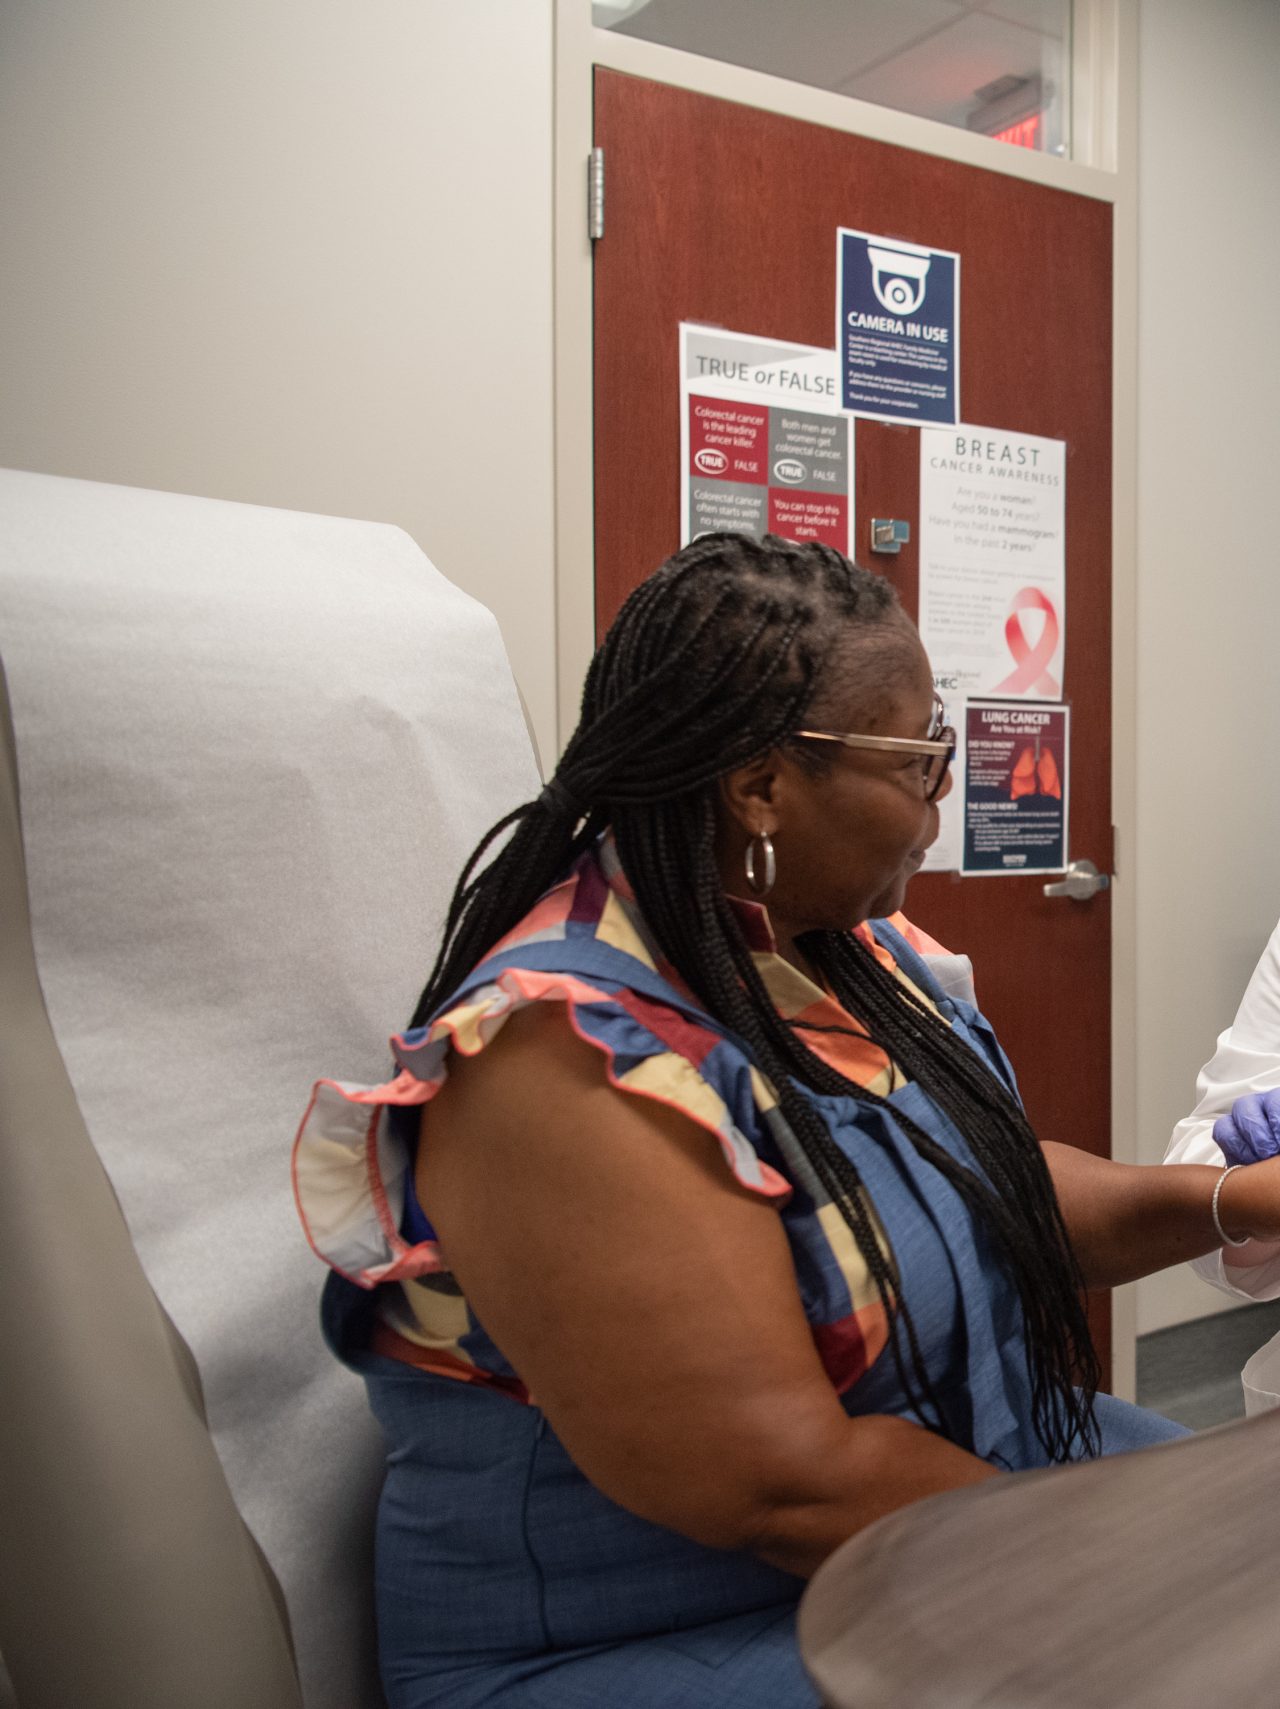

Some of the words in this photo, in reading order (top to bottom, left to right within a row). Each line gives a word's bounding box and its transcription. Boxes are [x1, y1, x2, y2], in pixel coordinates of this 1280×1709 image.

[847, 311, 905, 336] CAMERA
[906, 322, 921, 338] IN
[923, 325, 949, 343] USE
[696, 355, 749, 382] TRUE
[754, 370, 775, 385] or
[779, 370, 835, 396] FALSE
[694, 405, 736, 421] Colorectal
[737, 412, 765, 426] cancer
[702, 420, 710, 430] is
[710, 421, 725, 432] the
[726, 423, 757, 438] leading
[781, 418, 800, 431] Both
[801, 422, 819, 433] men
[820, 423, 837, 436] and
[705, 434, 732, 446] cancer
[786, 433, 816, 446] women
[817, 435, 831, 448] get
[775, 442, 814, 456] colorectal
[956, 437, 1040, 467] BREAST
[700, 455, 724, 468] TRUE
[734, 460, 758, 472] FALSE
[930, 457, 983, 474] CANCER
[988, 466, 1059, 487] AWARENESS
[780, 466, 803, 479] TRUE
[812, 469, 837, 482] FALSE
[693, 489, 734, 504] Colorectal
[734, 495, 762, 507] cancer
[696, 503, 718, 515] often
[719, 505, 741, 518] starts
[741, 507, 760, 519] with
[774, 499, 790, 511] You
[790, 502, 806, 512] can
[806, 503, 824, 515] stop
[824, 504, 840, 516] this
[977, 504, 989, 516] 50
[990, 506, 1000, 517] to
[1002, 508, 1013, 519] 74
[700, 516, 711, 525] no
[776, 512, 803, 524] cancer
[804, 513, 829, 526] before
[981, 710, 1010, 724] LUNG
[1010, 712, 1051, 726] CANCER
